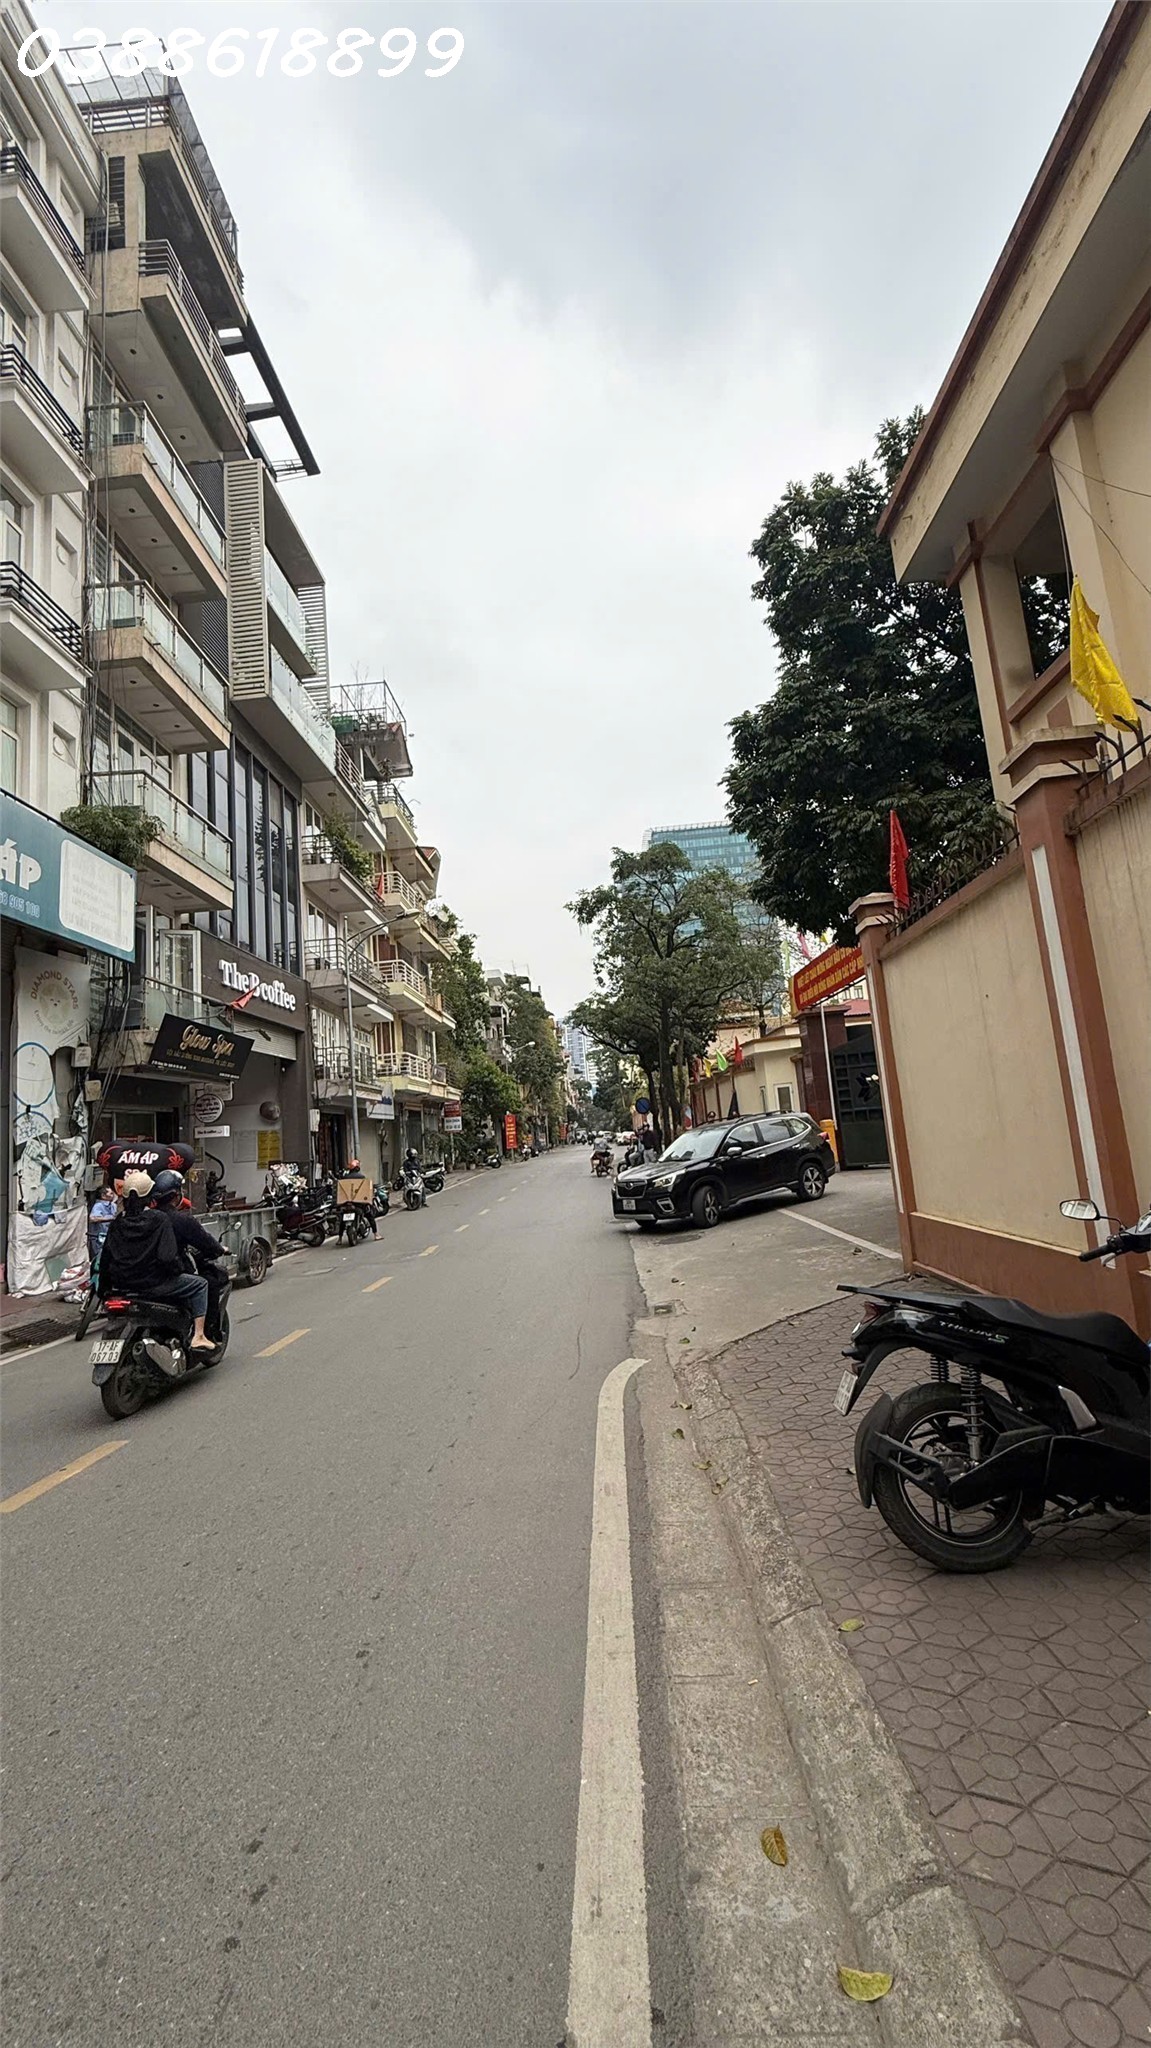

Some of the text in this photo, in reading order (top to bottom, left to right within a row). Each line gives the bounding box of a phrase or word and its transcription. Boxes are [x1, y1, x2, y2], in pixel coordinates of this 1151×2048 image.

[30, 970, 79, 1009] DIAMOND STARS
[260, 979, 296, 1011] coffee
[180, 1024, 212, 1050] Glow
[212, 1033, 235, 1059] Spa
